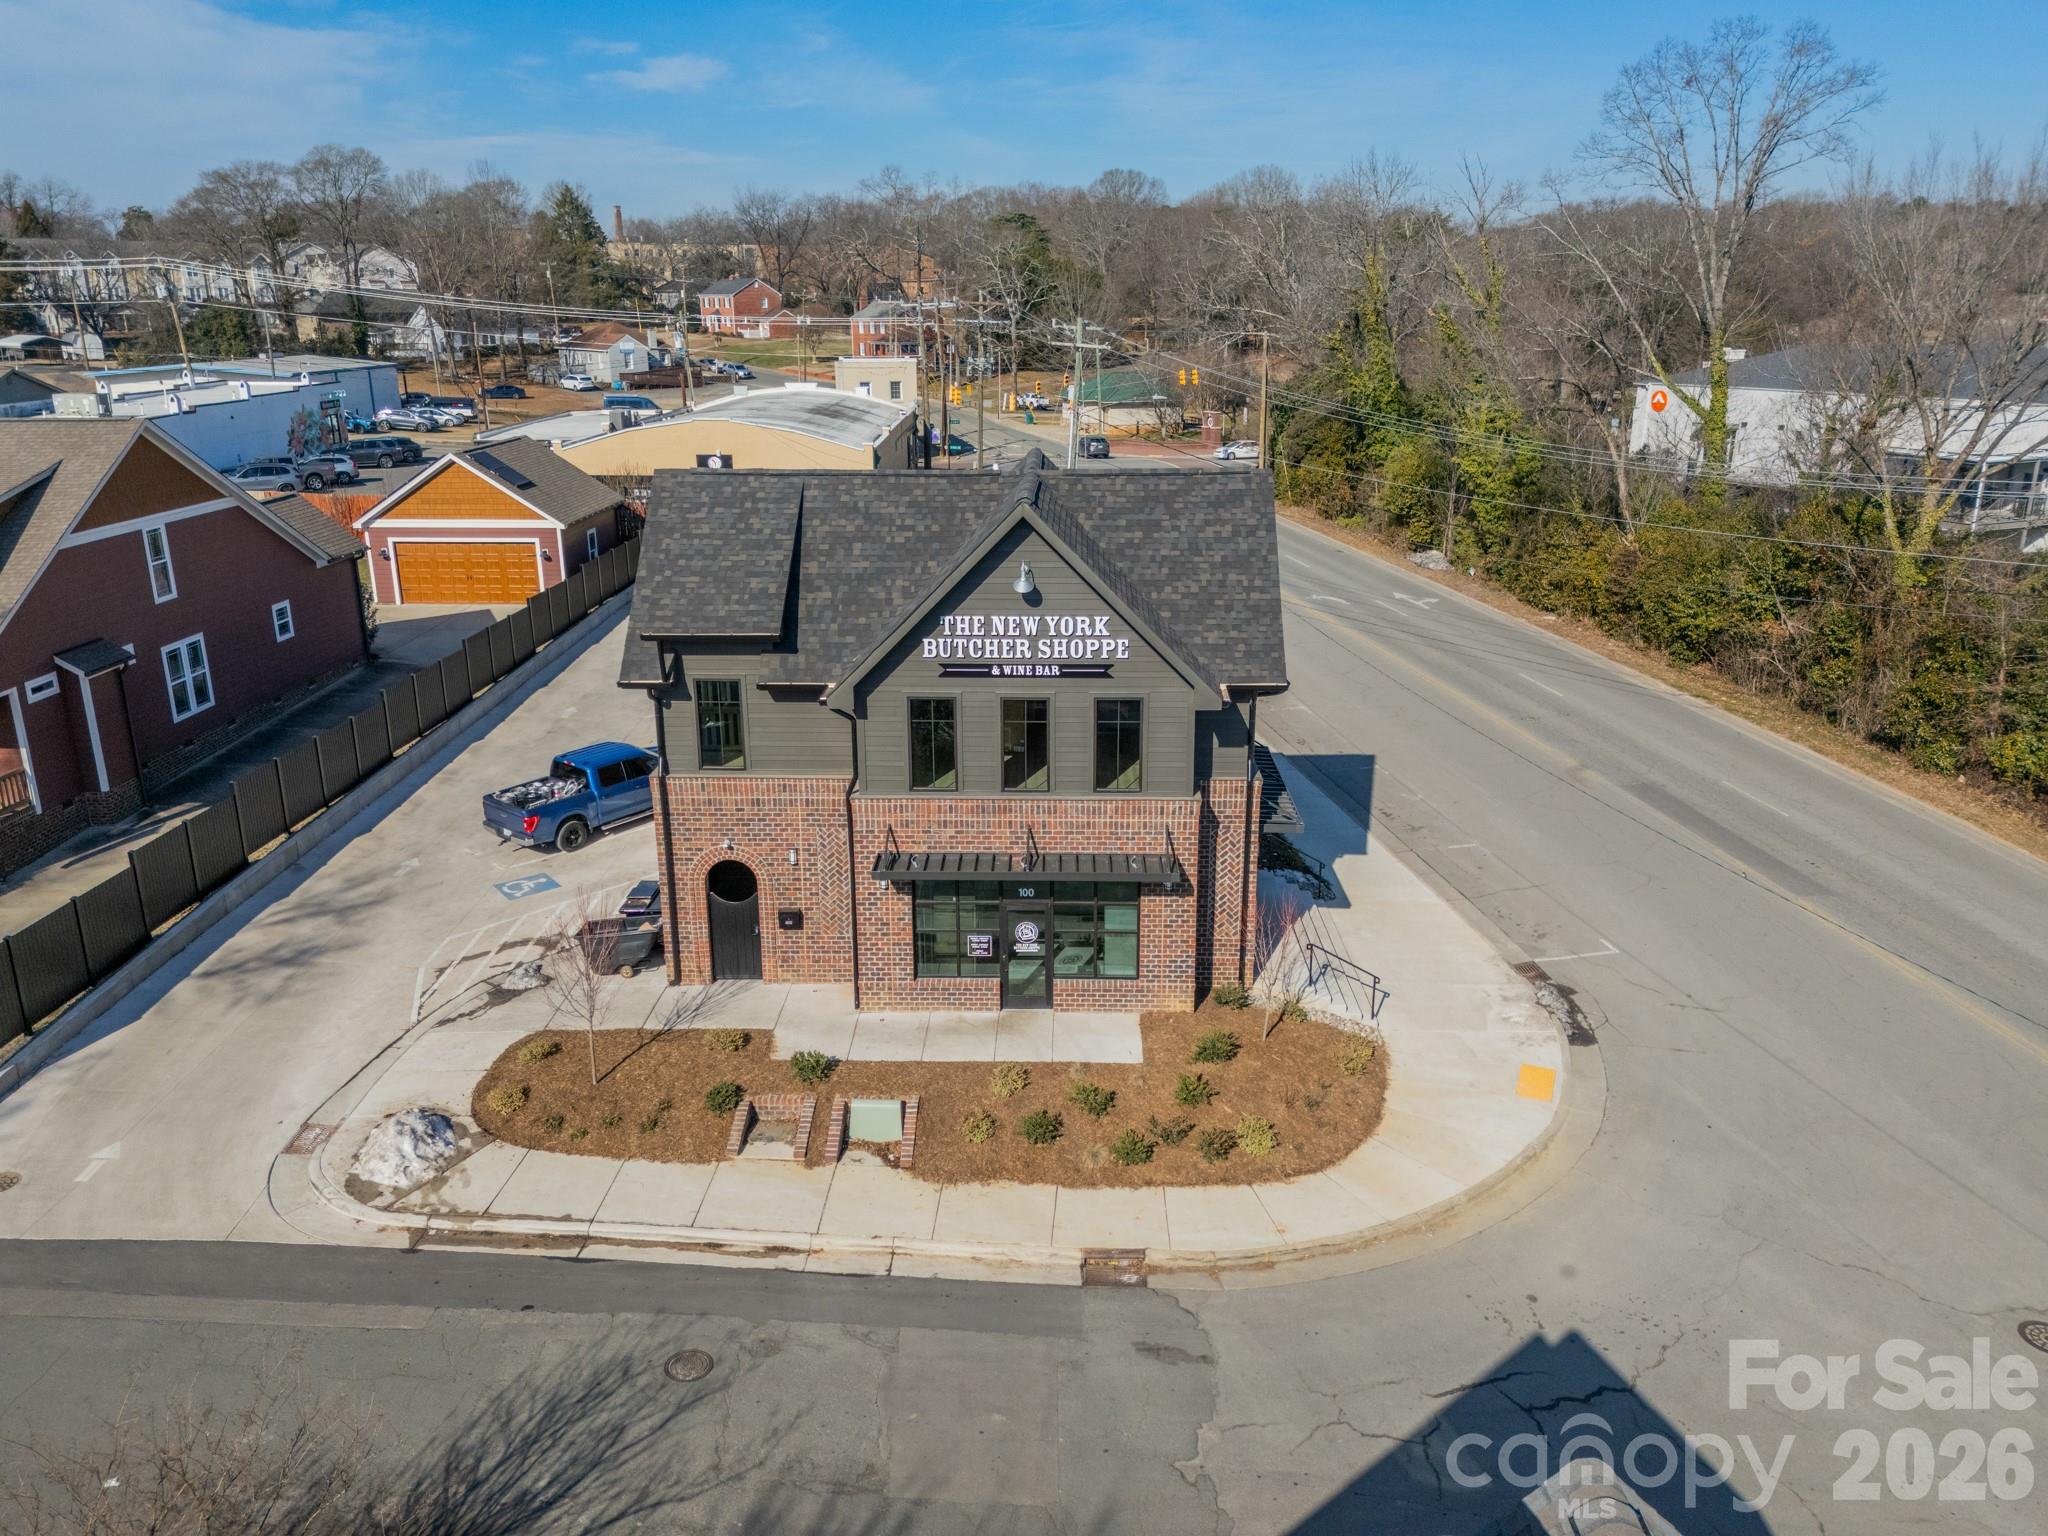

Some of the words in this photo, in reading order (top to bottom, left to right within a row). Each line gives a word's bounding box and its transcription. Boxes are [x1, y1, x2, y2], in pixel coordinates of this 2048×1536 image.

[940, 616, 985, 636] THE
[991, 616, 1041, 636] NEW
[1045, 616, 1110, 636] YORK
[922, 638, 1032, 659] BUTCHER
[1038, 638, 1129, 659] SHOPPE
[991, 665, 1001, 676] &
[1003, 665, 1033, 676] WINE
[1035, 665, 1060, 676] BAR
[1018, 888, 1035, 897] 100
